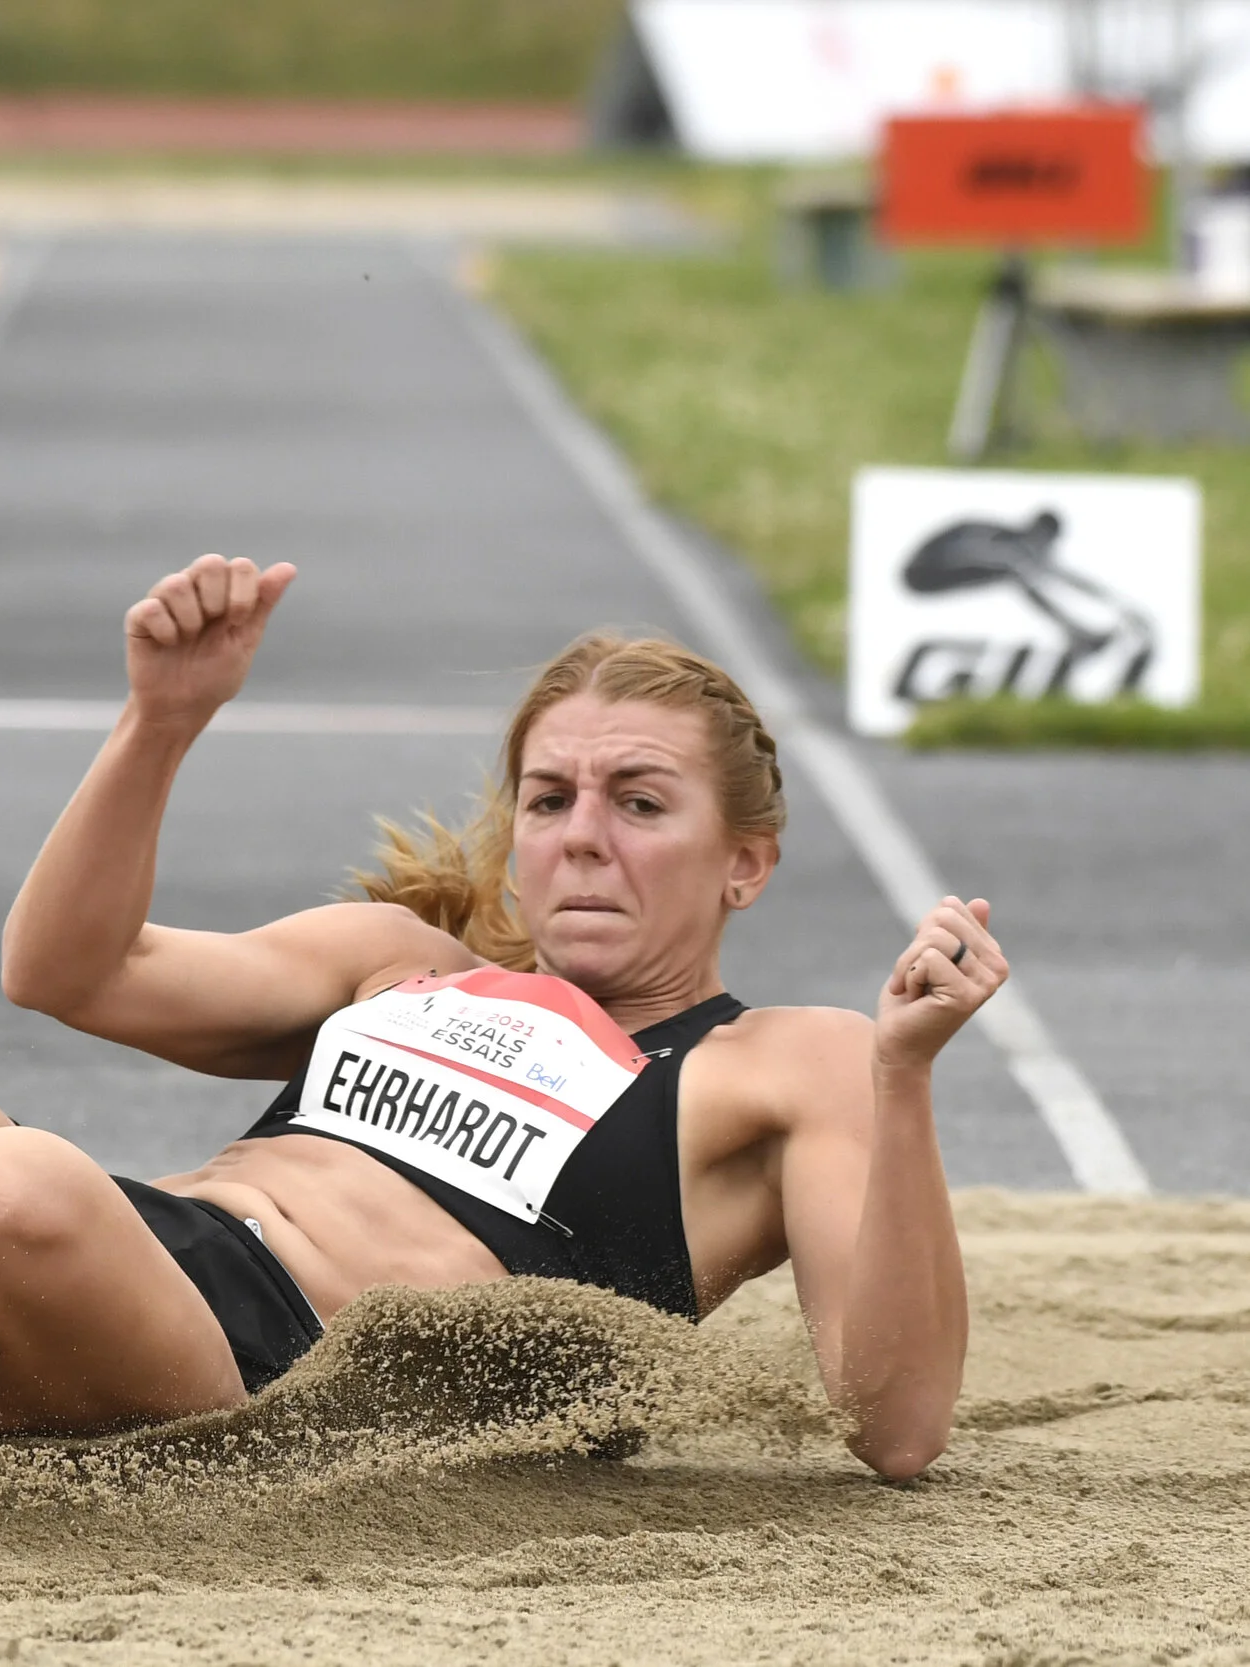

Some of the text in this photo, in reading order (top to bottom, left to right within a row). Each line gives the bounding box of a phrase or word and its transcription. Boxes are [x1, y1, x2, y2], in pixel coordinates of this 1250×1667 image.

[446, 1017, 527, 1053] TRIALS
[486, 1013, 535, 1037] 2021
[430, 1028, 516, 1069] ESSAIS
[525, 1062, 567, 1093] Bell
[322, 1050, 548, 1182] EHRHARDT
